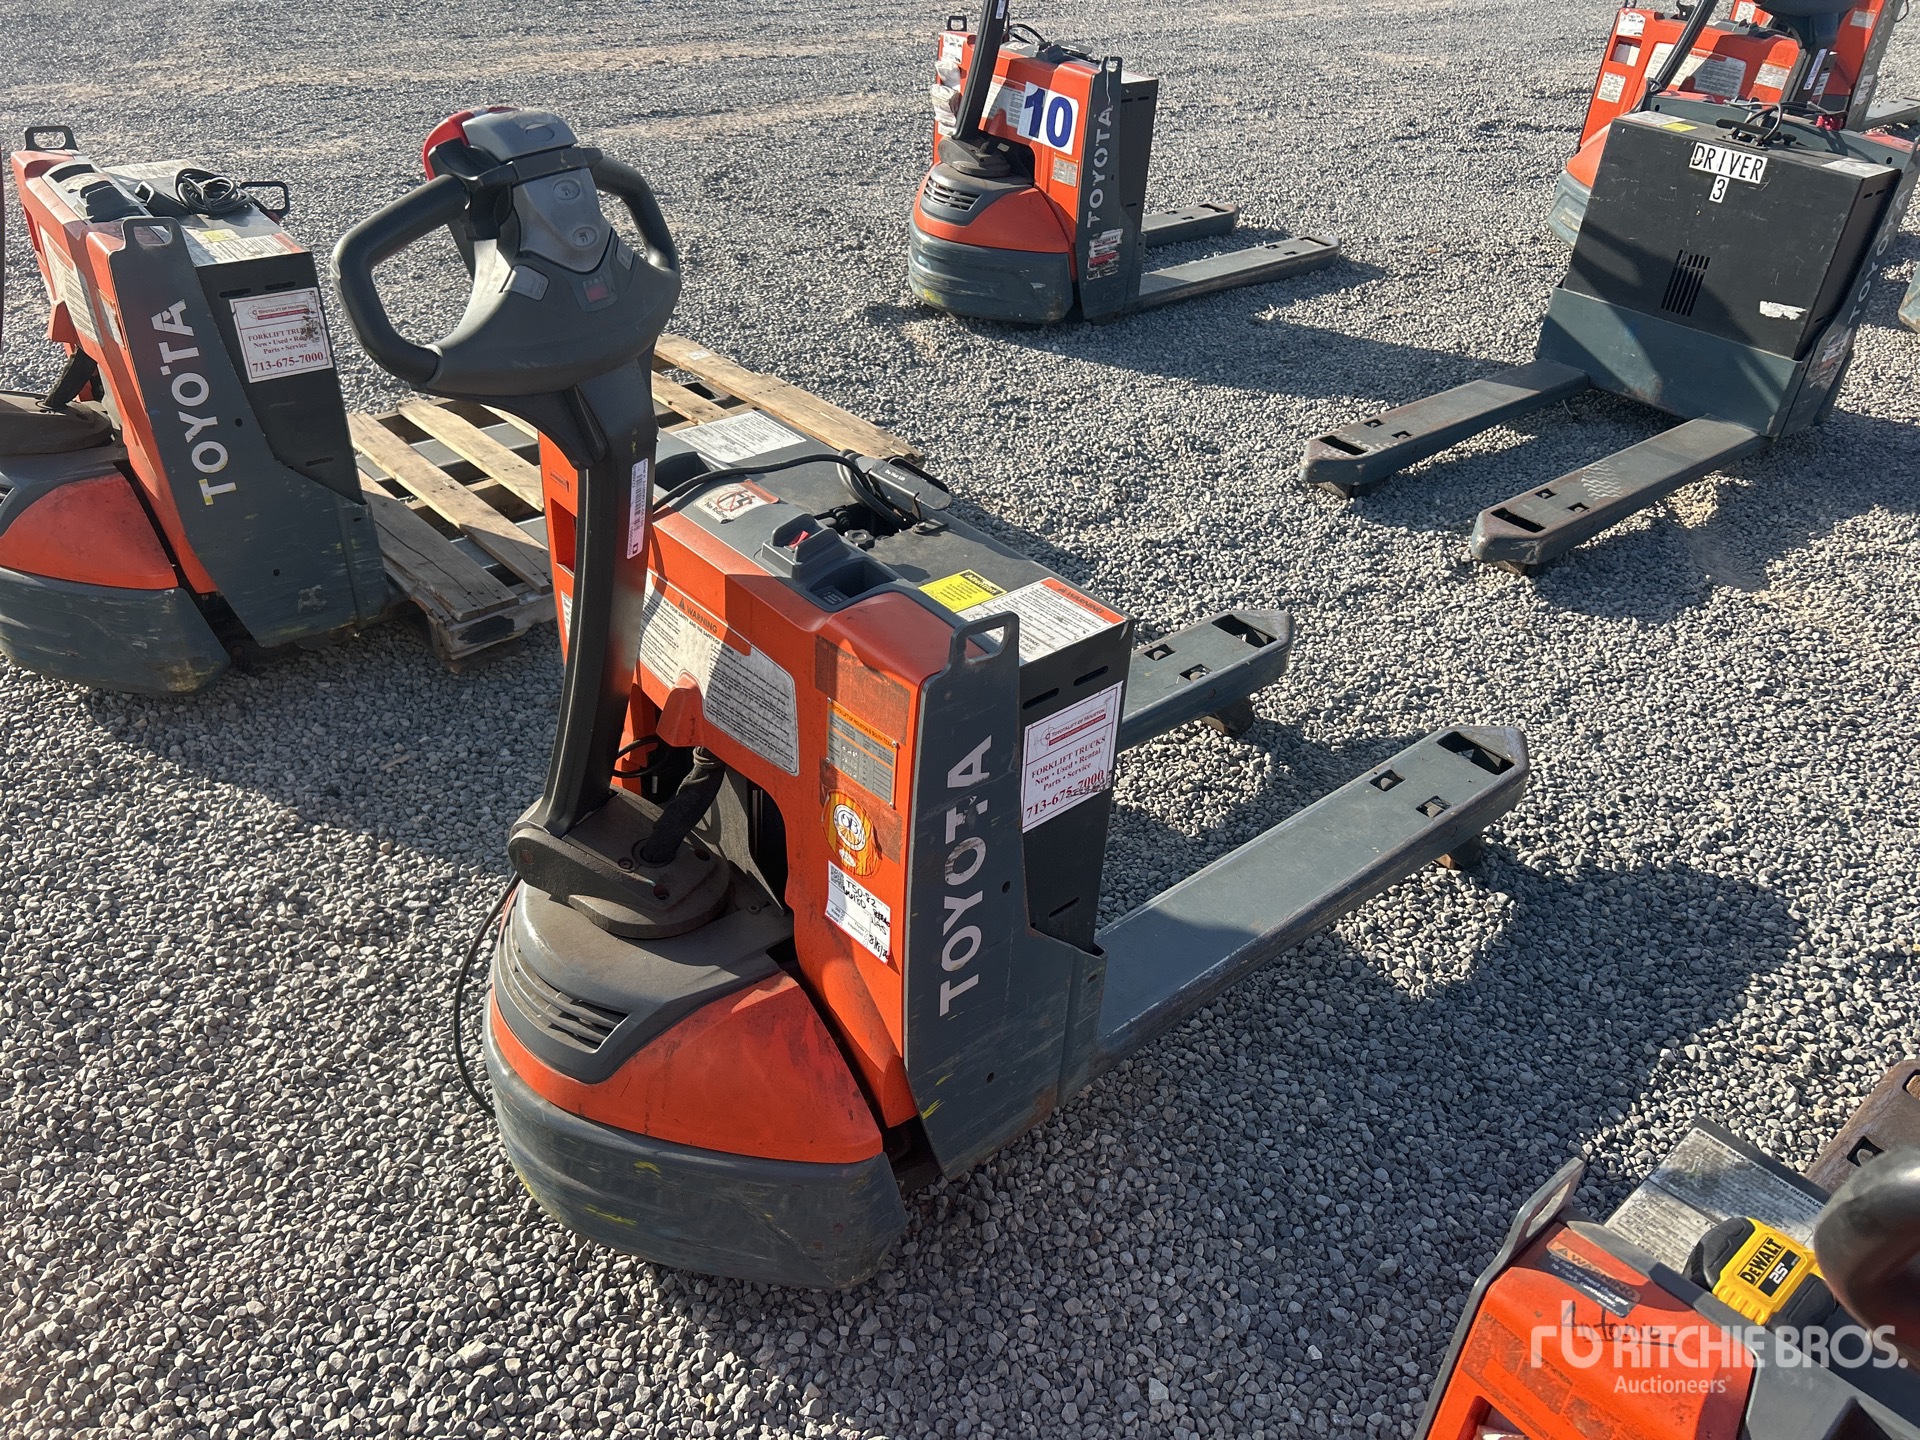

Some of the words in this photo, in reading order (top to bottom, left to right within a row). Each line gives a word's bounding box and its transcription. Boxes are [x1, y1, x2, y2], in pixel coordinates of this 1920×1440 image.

[1025, 87, 1073, 148] 10
[1086, 104, 1114, 229] TOYOTA
[1691, 144, 1764, 181] DRIVER
[1712, 178, 1726, 200] 3
[248, 330, 285, 342] FORKLIFT
[254, 341, 267, 349] New
[272, 337, 289, 346] Used
[263, 346, 281, 355] Parts
[285, 342, 308, 351] Service
[252, 351, 324, 373] 713-675-7000
[151, 298, 237, 506] TOYOTA
[1064, 590, 1105, 614] WARNING
[686, 604, 718, 634] WARNING
[1031, 753, 1074, 779] FORKLIFT
[1074, 735, 1106, 757] TRUCKS
[1035, 775, 1050, 787] New
[1056, 761, 1074, 775] Used
[1079, 747, 1102, 764] Rental
[1043, 778, 1062, 792] Parts
[1066, 762, 1092, 779] Service
[939, 734, 993, 1017] TOYOTA
[1571, 1253, 1637, 1299] WARNING
[1600, 1286, 1629, 1307] charger
